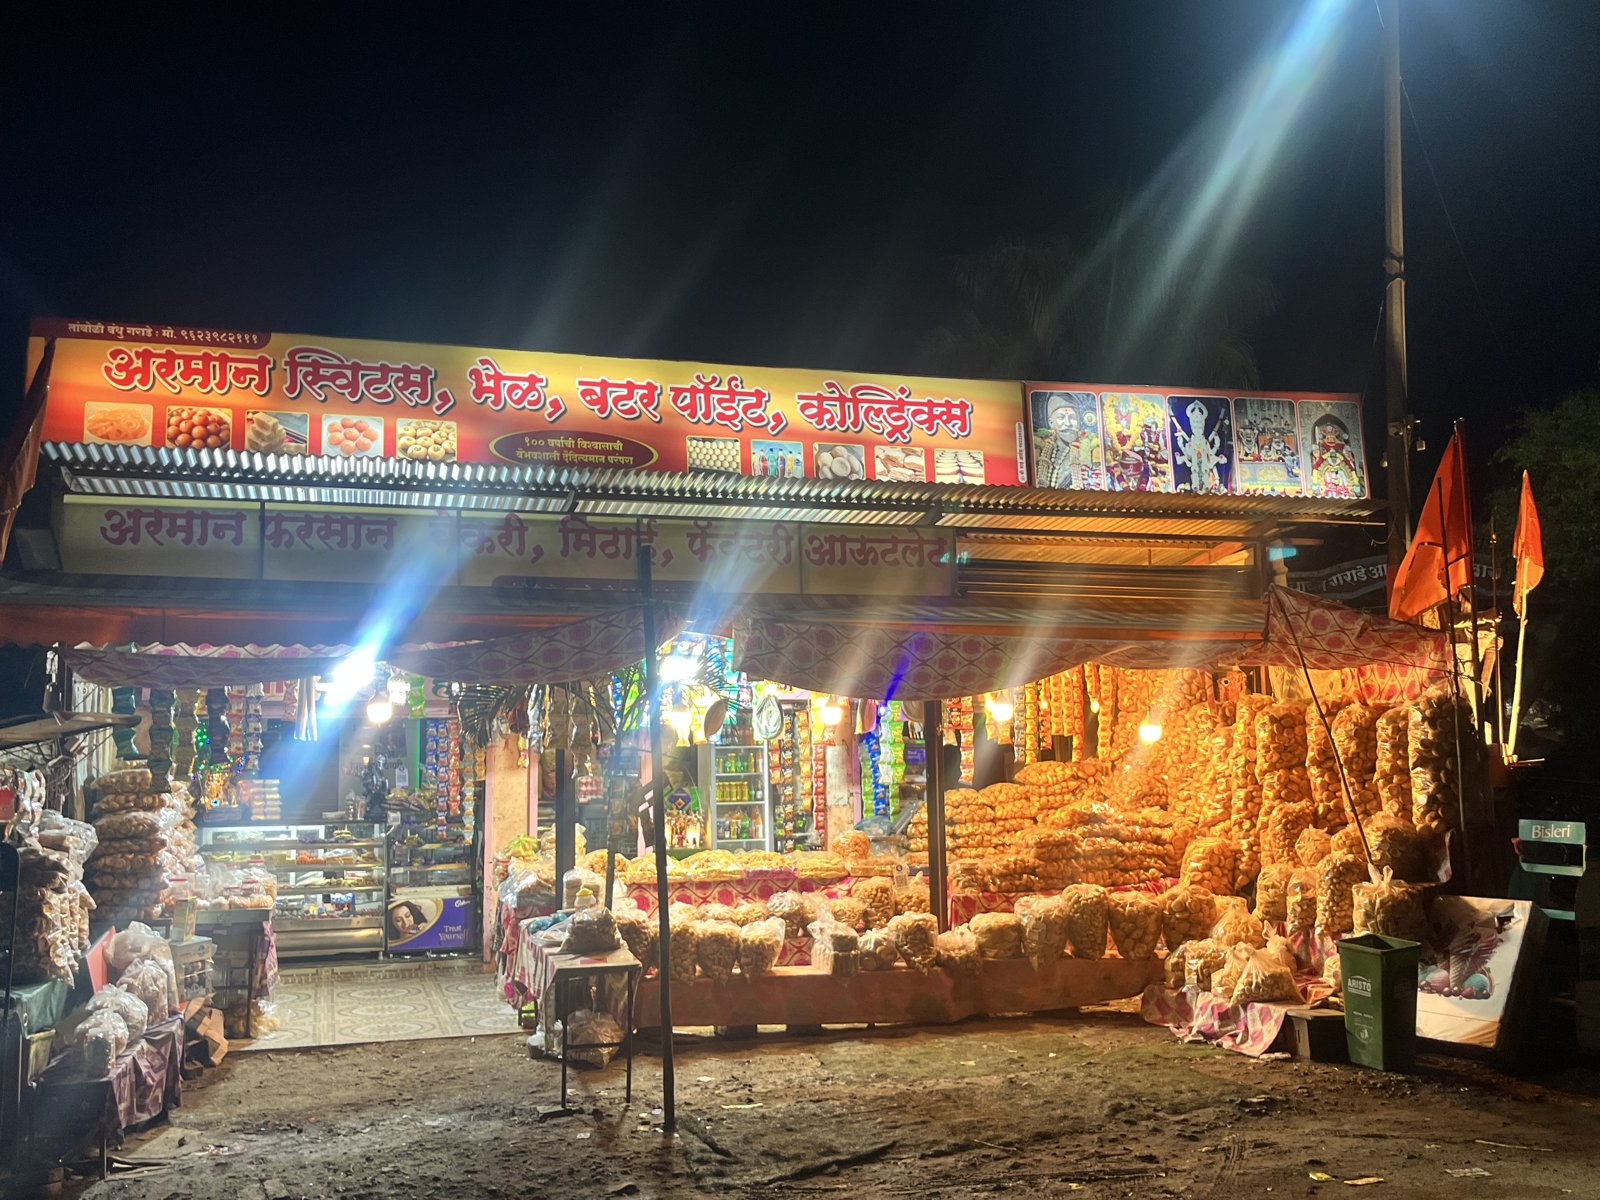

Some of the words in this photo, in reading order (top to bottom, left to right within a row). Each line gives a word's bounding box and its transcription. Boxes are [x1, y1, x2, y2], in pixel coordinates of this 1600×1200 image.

[126, 325, 153, 337] गराडे
[101, 345, 274, 396] अरमान
[283, 343, 456, 415] स्विटस,
[468, 355, 567, 422] भेळ,
[577, 376, 662, 423] बटर
[669, 372, 788, 435] पॉईंट,
[99, 508, 247, 547] अरमान
[263, 512, 398, 551] फरसान
[805, 528, 948, 569] आऊटलेट
[1532, 823, 1571, 839] Bisleri
[1347, 978, 1372, 992] ARISTO
